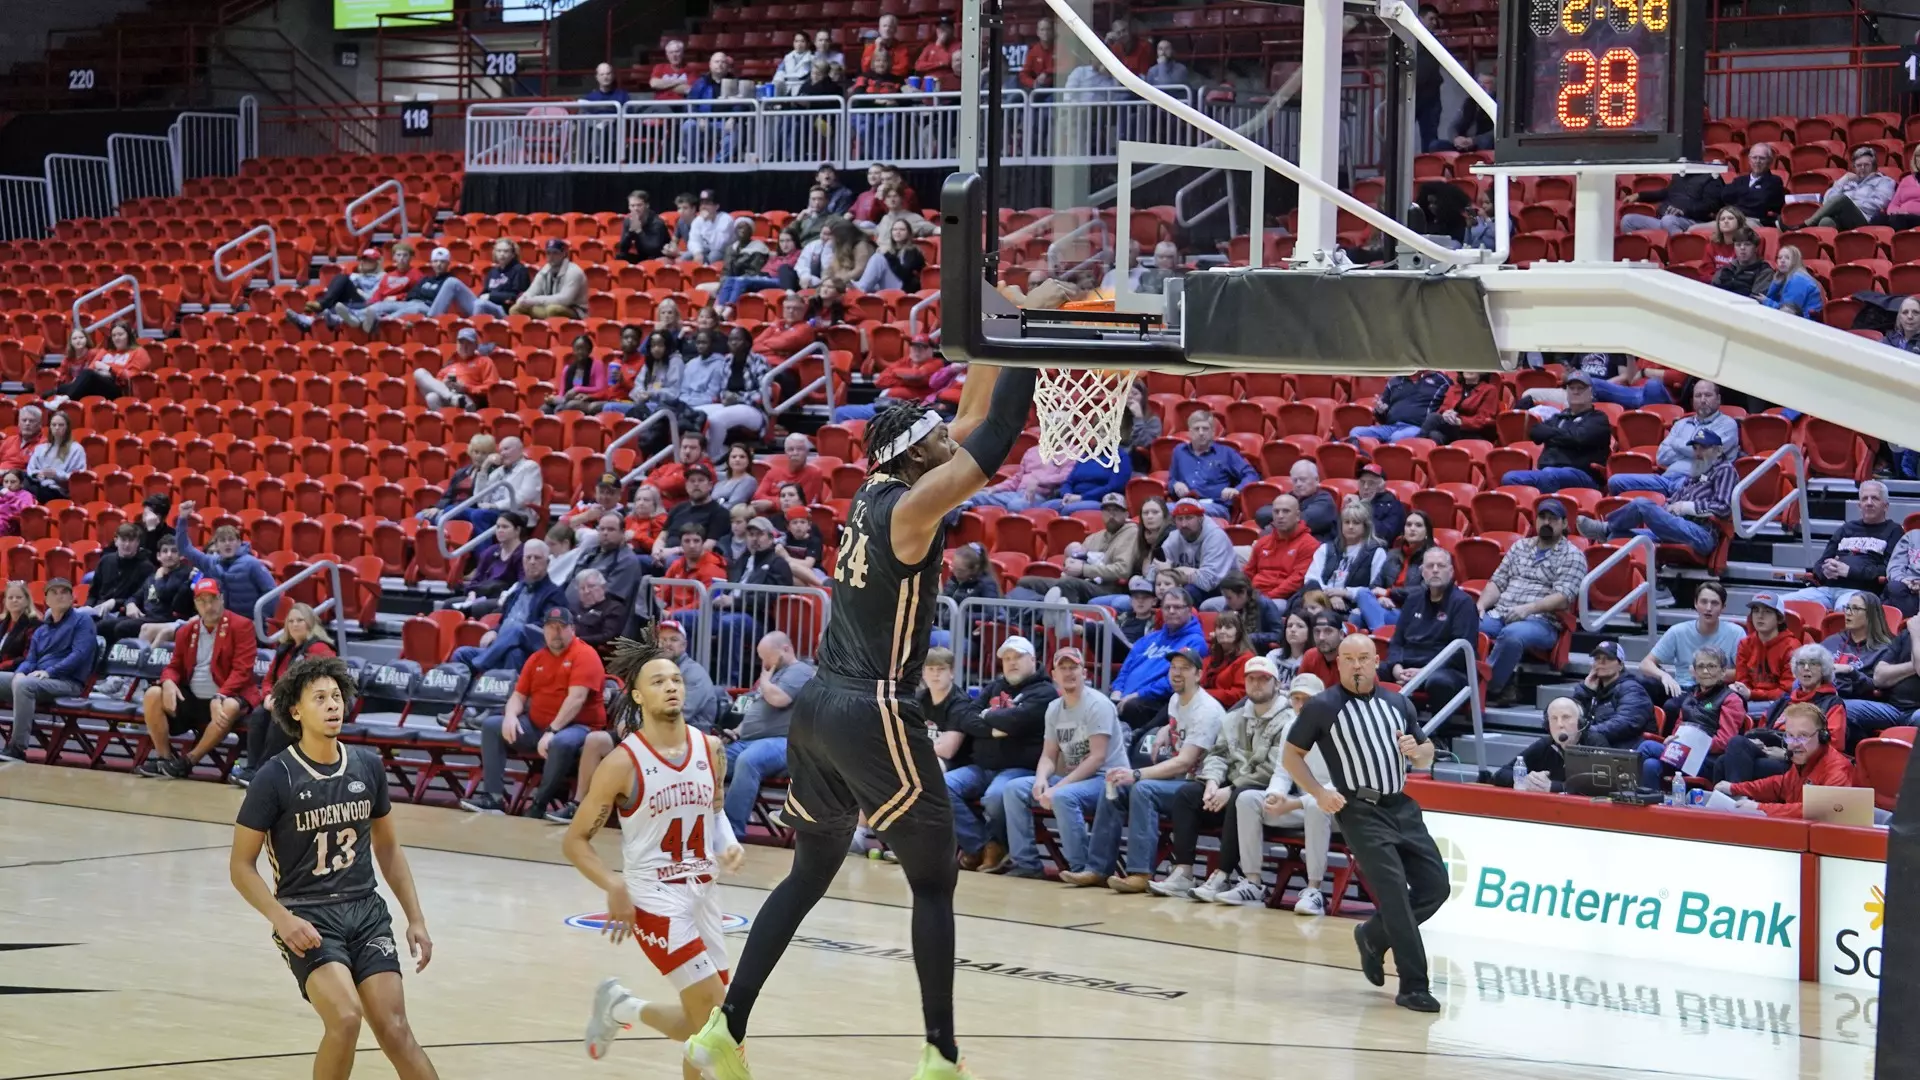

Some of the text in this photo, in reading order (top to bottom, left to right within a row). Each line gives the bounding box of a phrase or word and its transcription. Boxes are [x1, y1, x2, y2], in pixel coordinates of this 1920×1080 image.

[69, 69, 94, 89] 220
[486, 53, 516, 76] 218
[1558, 50, 1637, 127] 28
[403, 108, 429, 129] 118
[834, 526, 869, 588] 24
[295, 800, 371, 831] LINDENWOOD
[660, 814, 706, 862] 44
[312, 828, 358, 876] 13
[1475, 866, 1796, 948] Banterra Bank
